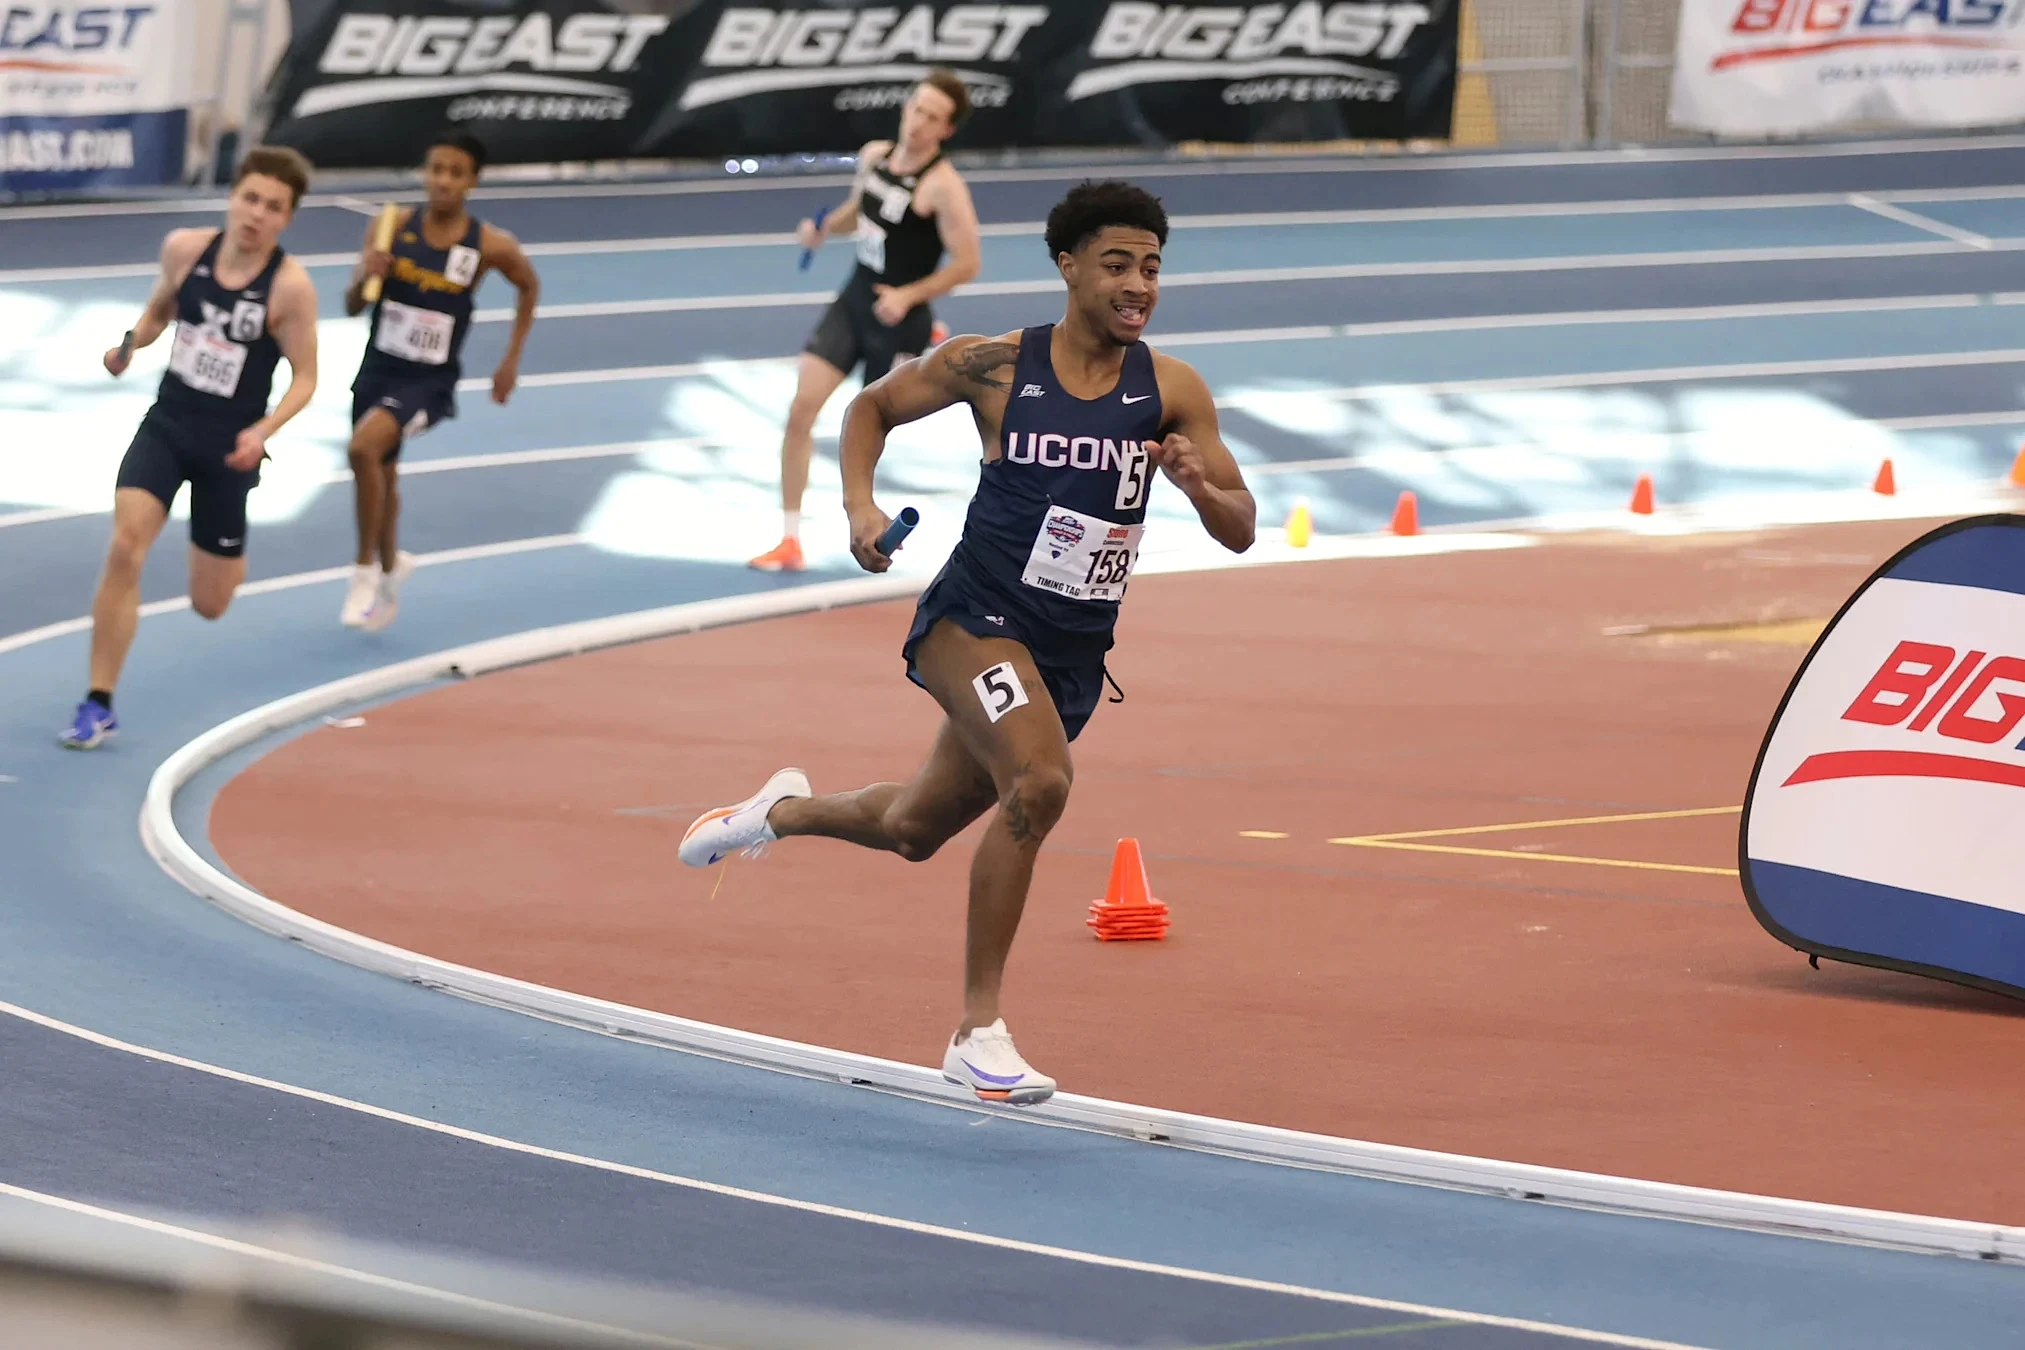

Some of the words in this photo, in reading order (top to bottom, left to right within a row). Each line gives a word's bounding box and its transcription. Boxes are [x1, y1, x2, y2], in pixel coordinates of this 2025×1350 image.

[1123, 456, 1143, 507] 5
[1037, 576, 1064, 594] TIMING
[1064, 584, 1081, 596] TAG
[1084, 549, 1130, 585] 158
[982, 666, 1015, 714] 5
